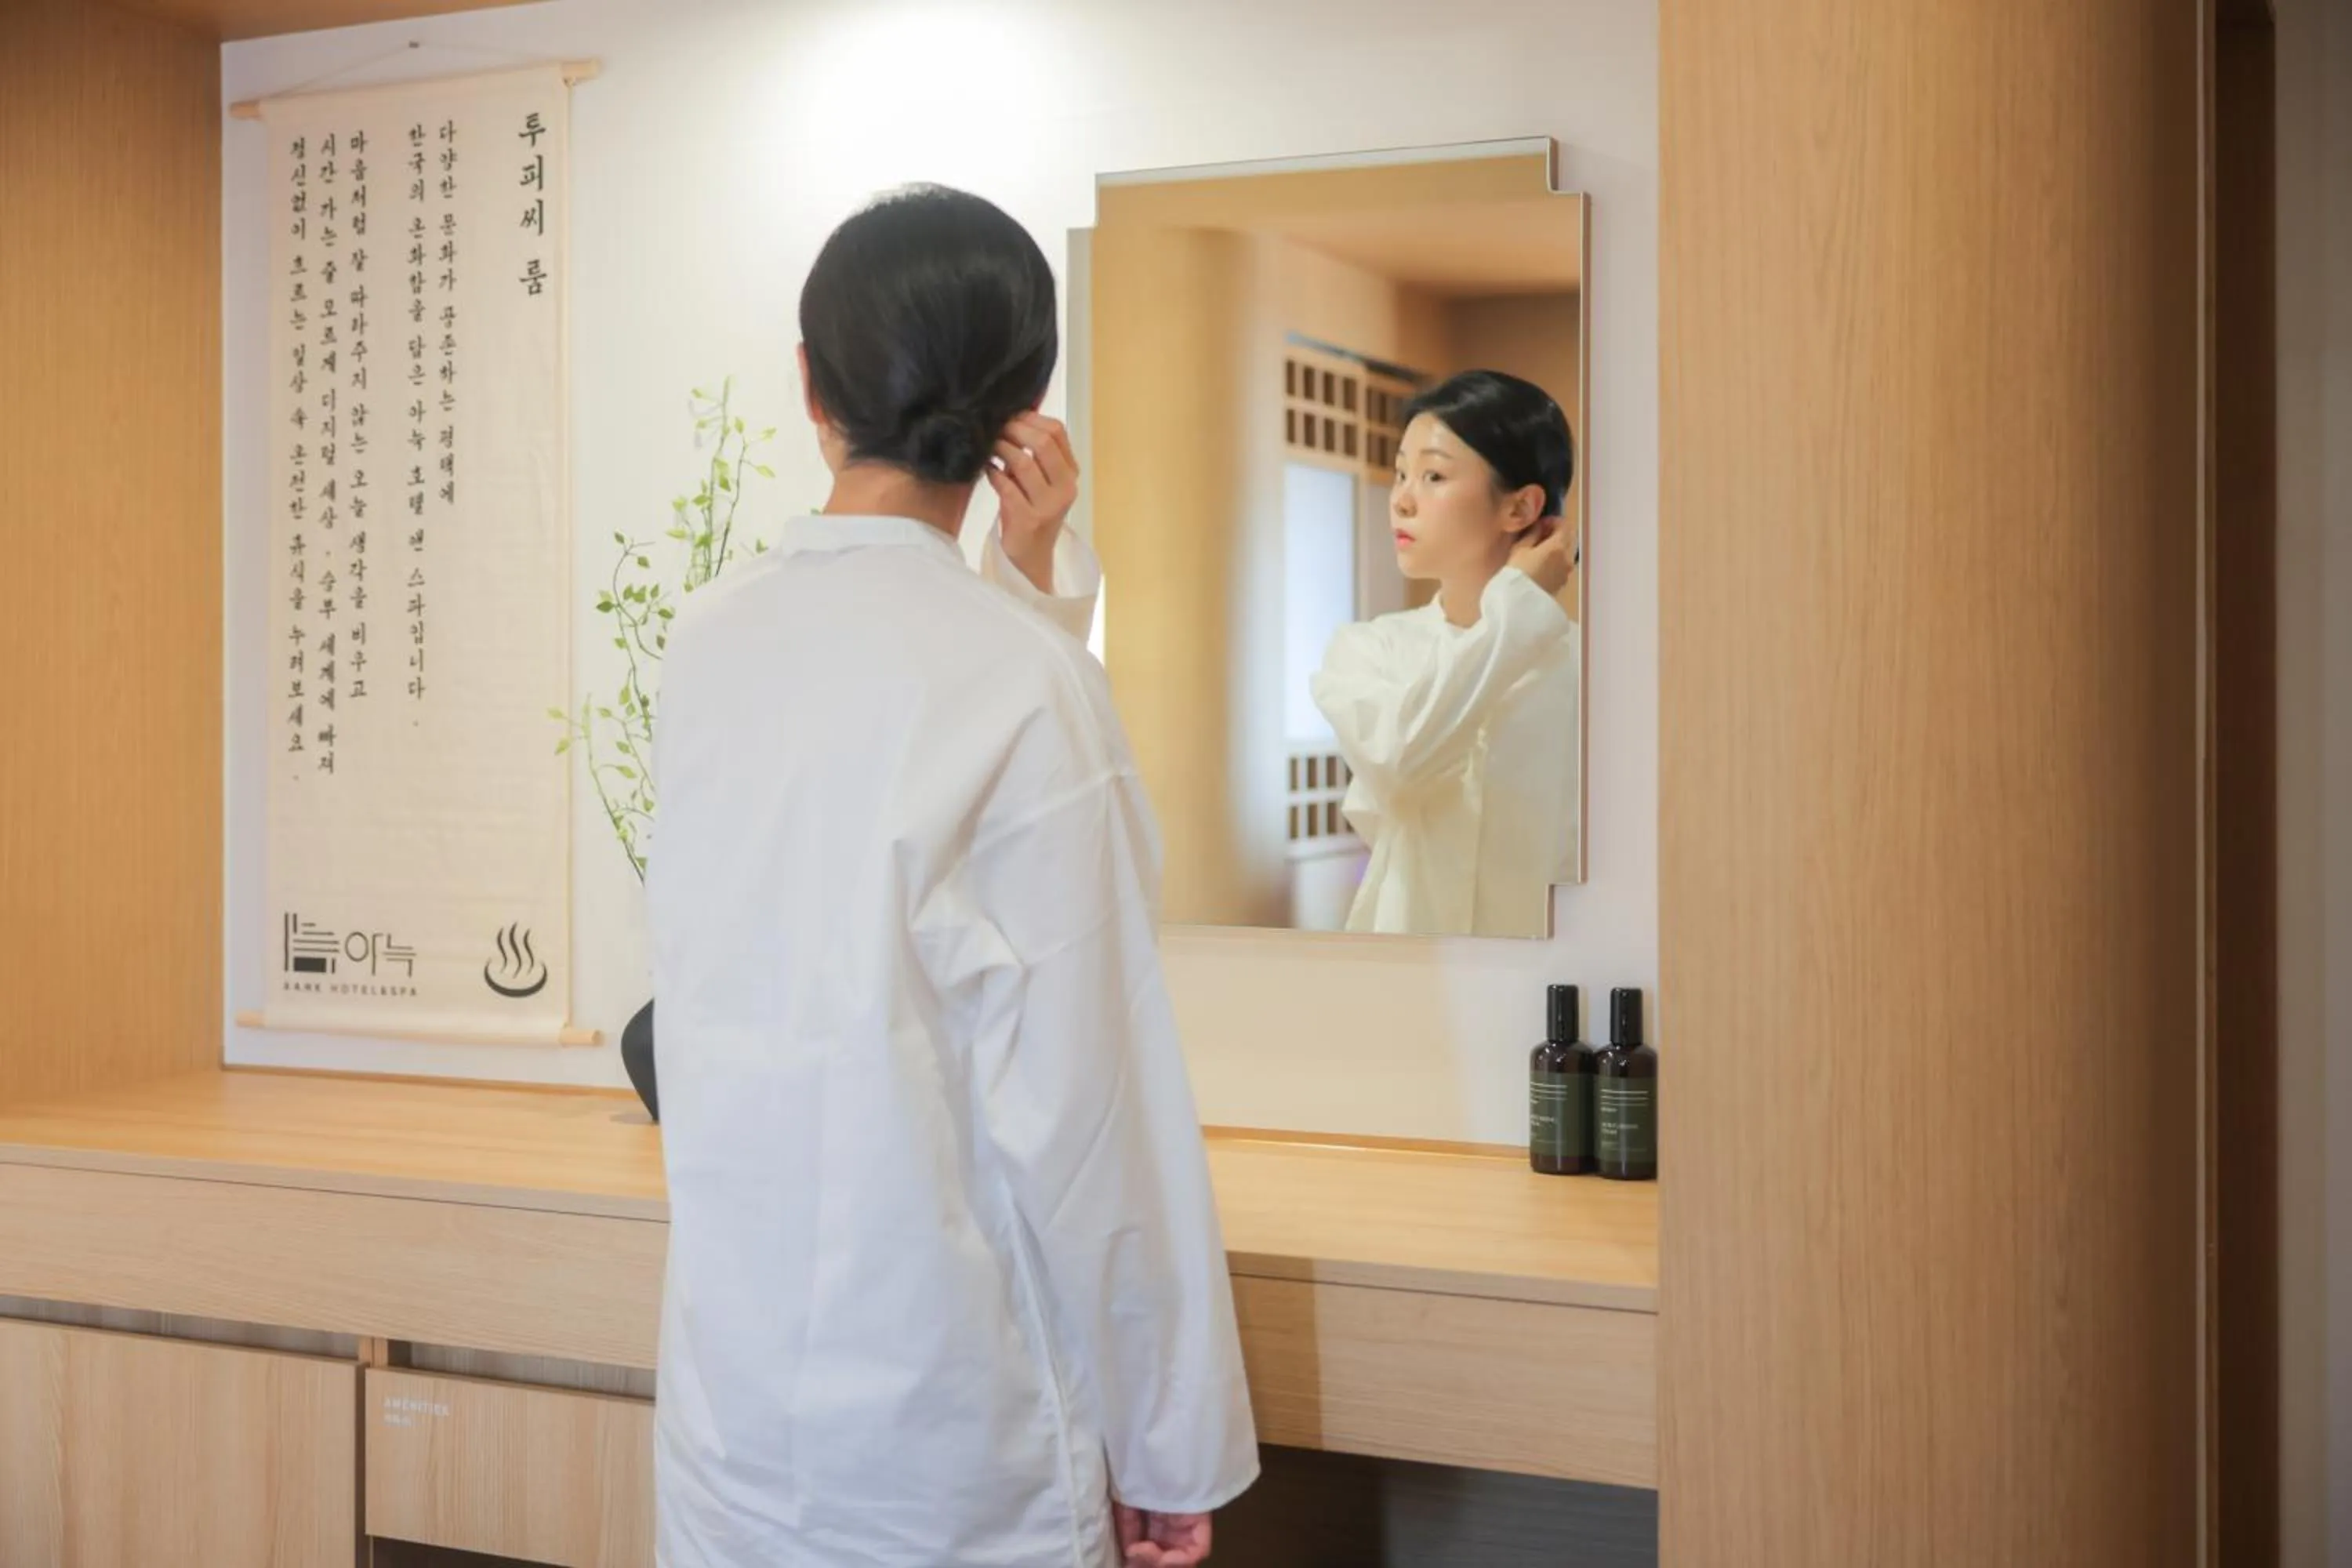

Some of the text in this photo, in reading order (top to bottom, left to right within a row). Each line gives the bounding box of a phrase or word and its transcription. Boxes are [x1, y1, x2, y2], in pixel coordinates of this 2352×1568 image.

[291, 136, 306, 240] 정신없이
[320, 133, 337, 184] 시간
[408, 123, 426, 202] 한국의
[320, 197, 337, 248] 가는
[518, 112, 547, 297] 투피씨 룸
[290, 255, 307, 331] 흐르는
[321, 260, 337, 284] 줄
[408, 216, 426, 323] 온화함을
[321, 299, 338, 373] 모르게
[438, 119, 457, 504] 다양한 문화가 공존하는 평택에
[290, 343, 307, 394] 일상
[408, 335, 426, 386] 담은
[291, 407, 307, 430] 속
[321, 389, 336, 466] 디지털
[350, 129, 368, 699] 마음처럼 잘 따라주지 않는 오늘 생각을 비우고
[408, 400, 426, 452] 아늑
[289, 443, 307, 521] 온전한
[407, 465, 426, 516] 호텔
[289, 533, 307, 611] 휴식을
[408, 528, 425, 553] 앤
[318, 570, 336, 620] 승부
[319, 633, 336, 710] 세계에
[318, 724, 336, 775] 빠져
